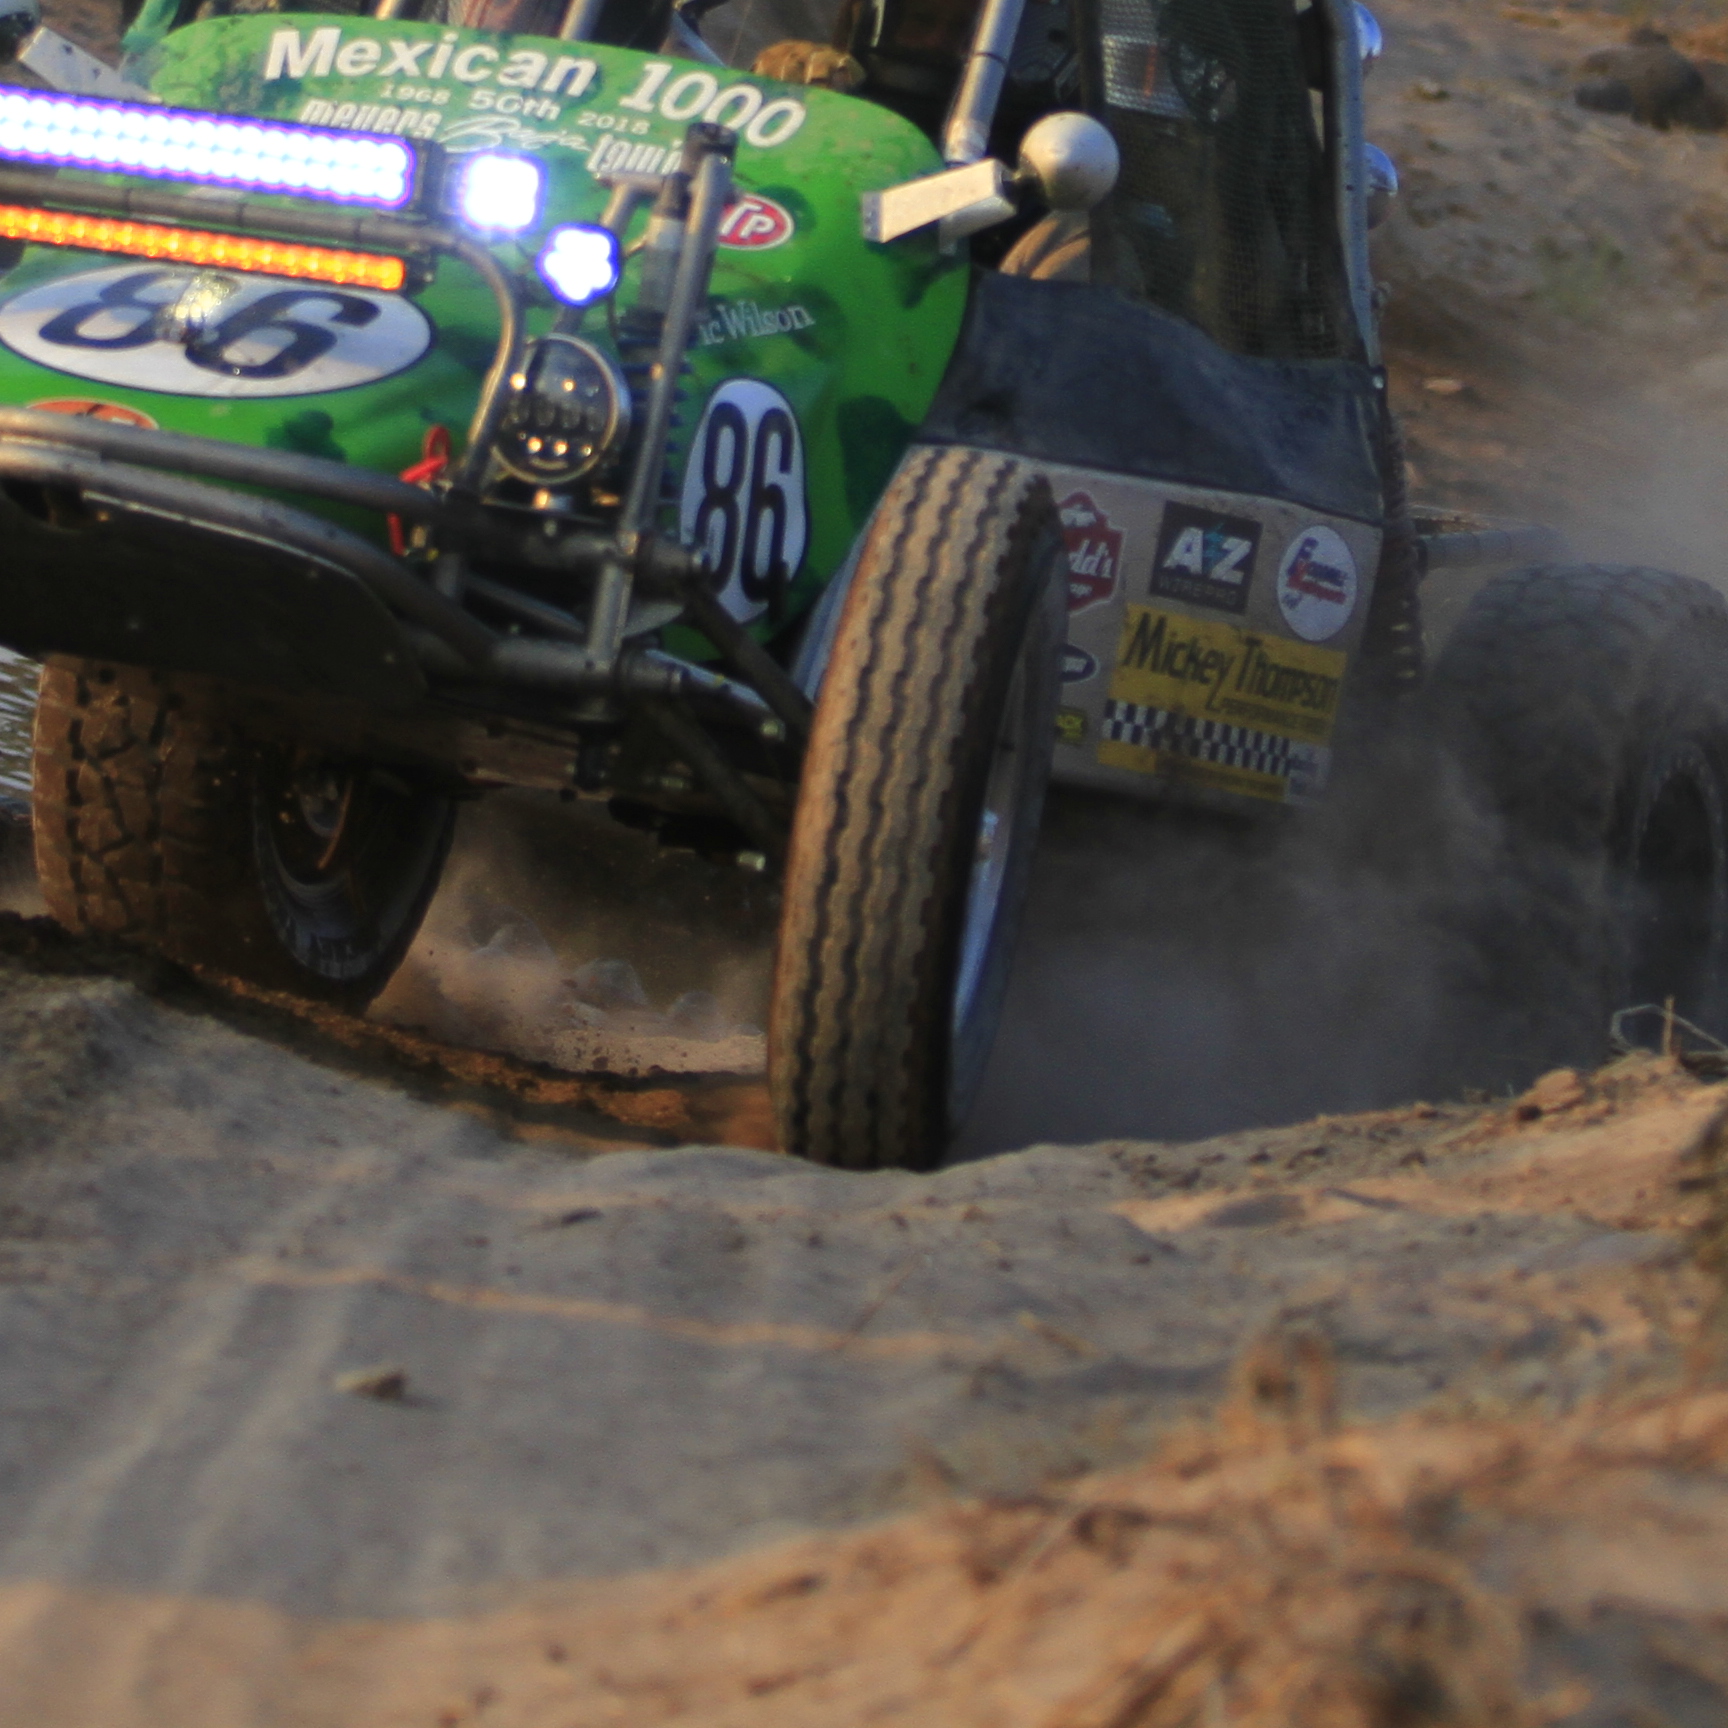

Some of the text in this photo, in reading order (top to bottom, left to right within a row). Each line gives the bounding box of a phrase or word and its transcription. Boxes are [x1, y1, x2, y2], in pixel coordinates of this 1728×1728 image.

[265, 27, 806, 148] Mexican 1000
[380, 83, 650, 135] 1968 50th 2018
[39, 271, 380, 380] 86
[716, 299, 816, 339] Wilson
[694, 401, 793, 604] 86
[1162, 526, 1253, 585] AZ
[1122, 612, 1235, 711] Mickey
